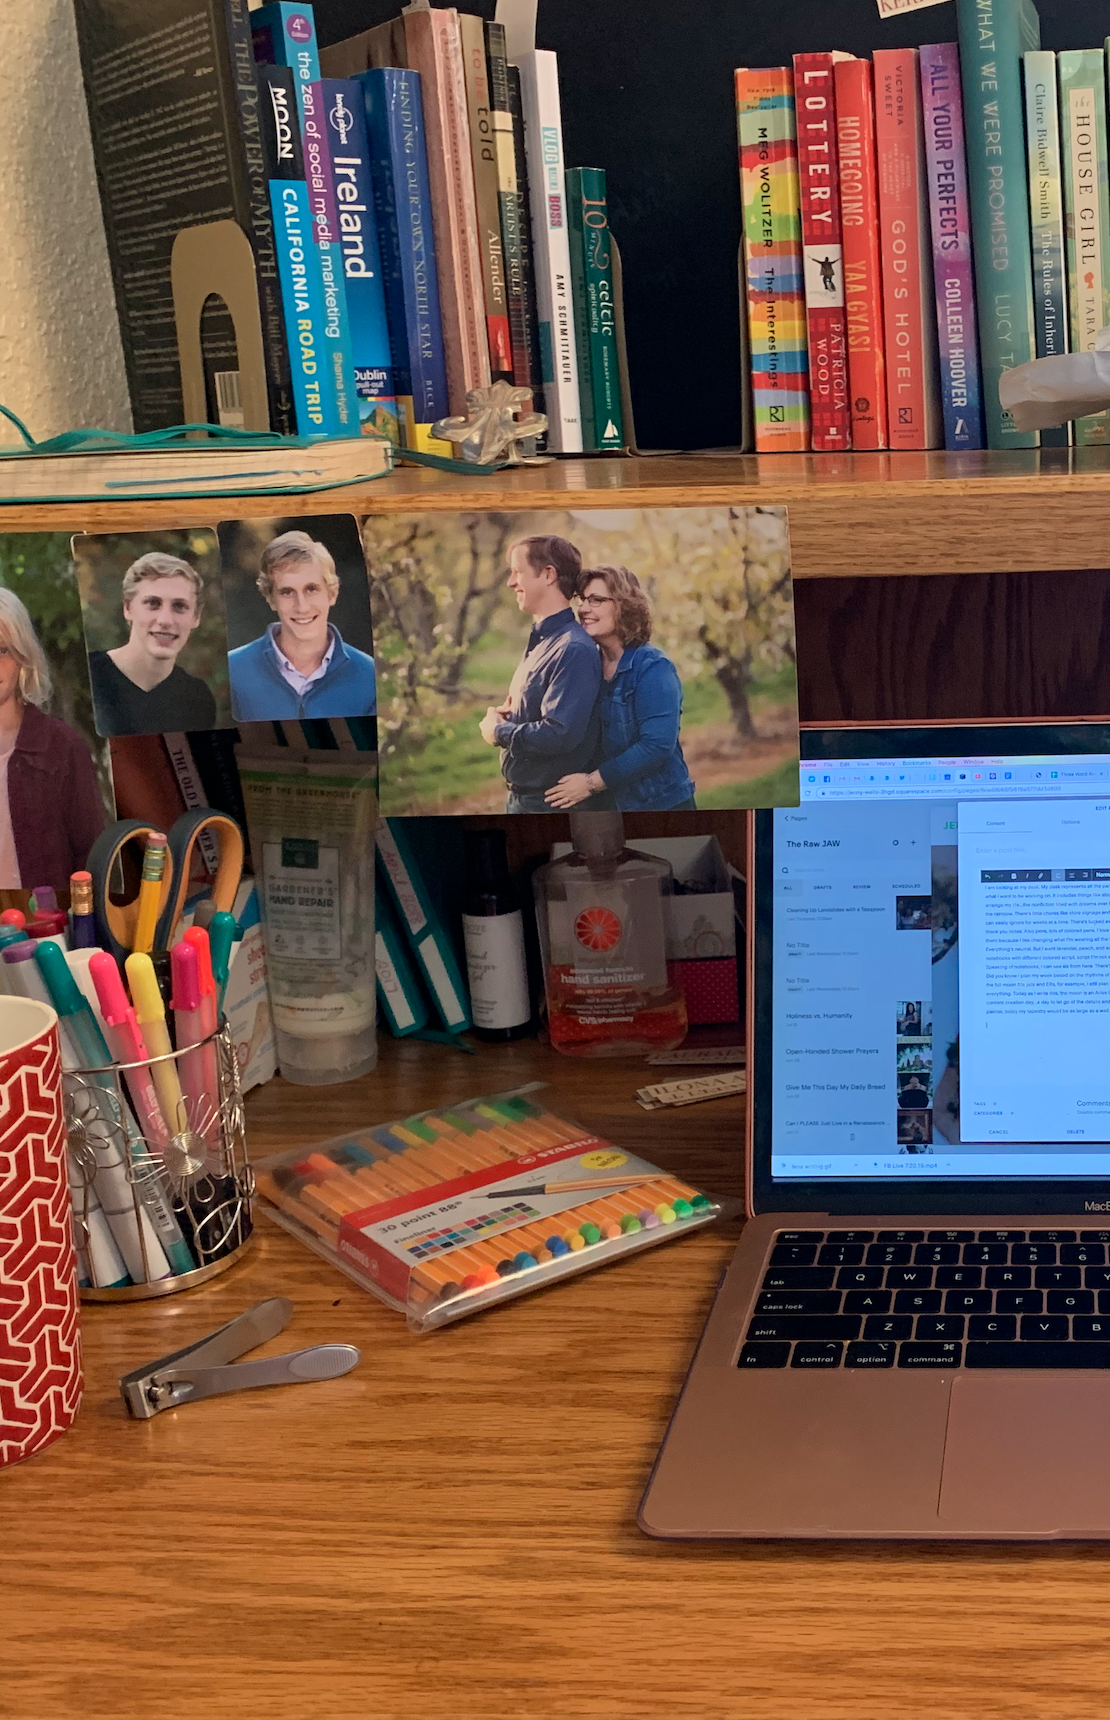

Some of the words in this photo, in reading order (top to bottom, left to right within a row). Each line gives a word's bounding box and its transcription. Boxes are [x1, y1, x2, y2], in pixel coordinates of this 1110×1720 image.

[975, 0, 996, 51] WHAT
[297, 51, 310, 80] the
[473, 48, 481, 69] to
[980, 62, 998, 91] WE
[301, 84, 315, 116] zen
[475, 77, 485, 100] be
[884, 75, 893, 117] SWEET
[895, 65, 904, 126] VICTORIA
[929, 64, 949, 96] ALL
[272, 87, 294, 159] MOON
[399, 80, 415, 153] FINDING
[1034, 83, 1046, 125] Claire
[237, 83, 264, 174] POWER
[306, 121, 321, 139] of
[478, 106, 495, 162] told
[543, 127, 559, 164] VLOG
[758, 127, 769, 160] MEG
[804, 70, 832, 223] LOTTERY
[932, 103, 953, 151] YOUR
[982, 100, 1002, 157] WERE
[308, 142, 328, 194] social
[838, 116, 864, 226] HOMEGOING
[1036, 128, 1050, 177] Bidwell
[1076, 114, 1094, 195] HOUSE
[406, 162, 419, 204] YOUR
[1039, 181, 1051, 219] Smith
[314, 198, 333, 250] media
[334, 157, 374, 278] Ireland
[505, 192, 518, 254] ARTIST'S
[549, 195, 563, 228] BOSS
[583, 196, 607, 229] 10
[760, 167, 773, 248] WOLITZER
[936, 160, 959, 252] PERFECTS
[987, 165, 1009, 271] PROMISED
[250, 201, 276, 277] MYTH
[282, 188, 310, 312] CALIFORNIA
[410, 212, 424, 252] OWN
[1041, 231, 1052, 256] The
[1079, 207, 1096, 265] GIRL
[488, 230, 503, 304] Allender
[511, 257, 521, 296] RULE
[845, 260, 867, 292] YAA
[891, 219, 909, 299] GOD'S
[1042, 260, 1054, 295] Rules
[320, 255, 341, 338] marketing
[414, 262, 429, 315] NORTH
[555, 274, 566, 298] AMY
[764, 267, 774, 294] The
[944, 278, 964, 346] COLLEEN
[995, 294, 1013, 342] LUCY
[1043, 298, 1054, 312] of
[1085, 297, 1096, 335] TARA
[297, 319, 317, 375] ROAD
[421, 323, 433, 359] STAR
[558, 305, 572, 383] SCHMITTAUER
[766, 300, 778, 387] Interestings
[846, 301, 871, 353] GYASI
[816, 338, 830, 395] WOOD
[830, 323, 845, 410] PATRICIA
[895, 313, 911, 394] HOTEL
[354, 370, 387, 381] Dublin
[425, 380, 435, 408] BECK
[949, 349, 968, 407] HOOVER
[305, 381, 322, 425] TRIP
[786, 840, 801, 848] The
[803, 840, 820, 848] Raw
[822, 840, 841, 848] JAW
[269, 896, 294, 905] HAND
[298, 898, 333, 908] REPAIR
[561, 974, 589, 984] hand
[593, 973, 643, 984] sanitizer
[823, 1013, 853, 1021] Humanity
[831, 1047, 855, 1055] Shower
[856, 1048, 879, 1056] Prayers
[654, 1078, 726, 1096] ILONA
[1077, 1099, 1110, 1107] Comments
[537, 1137, 599, 1159] STABILO
[377, 1223, 397, 1235] 30
[400, 1210, 438, 1229] point
[394, 1226, 437, 1245] Fineliner
[800, 1355, 833, 1363] control
[908, 1355, 953, 1363] command
